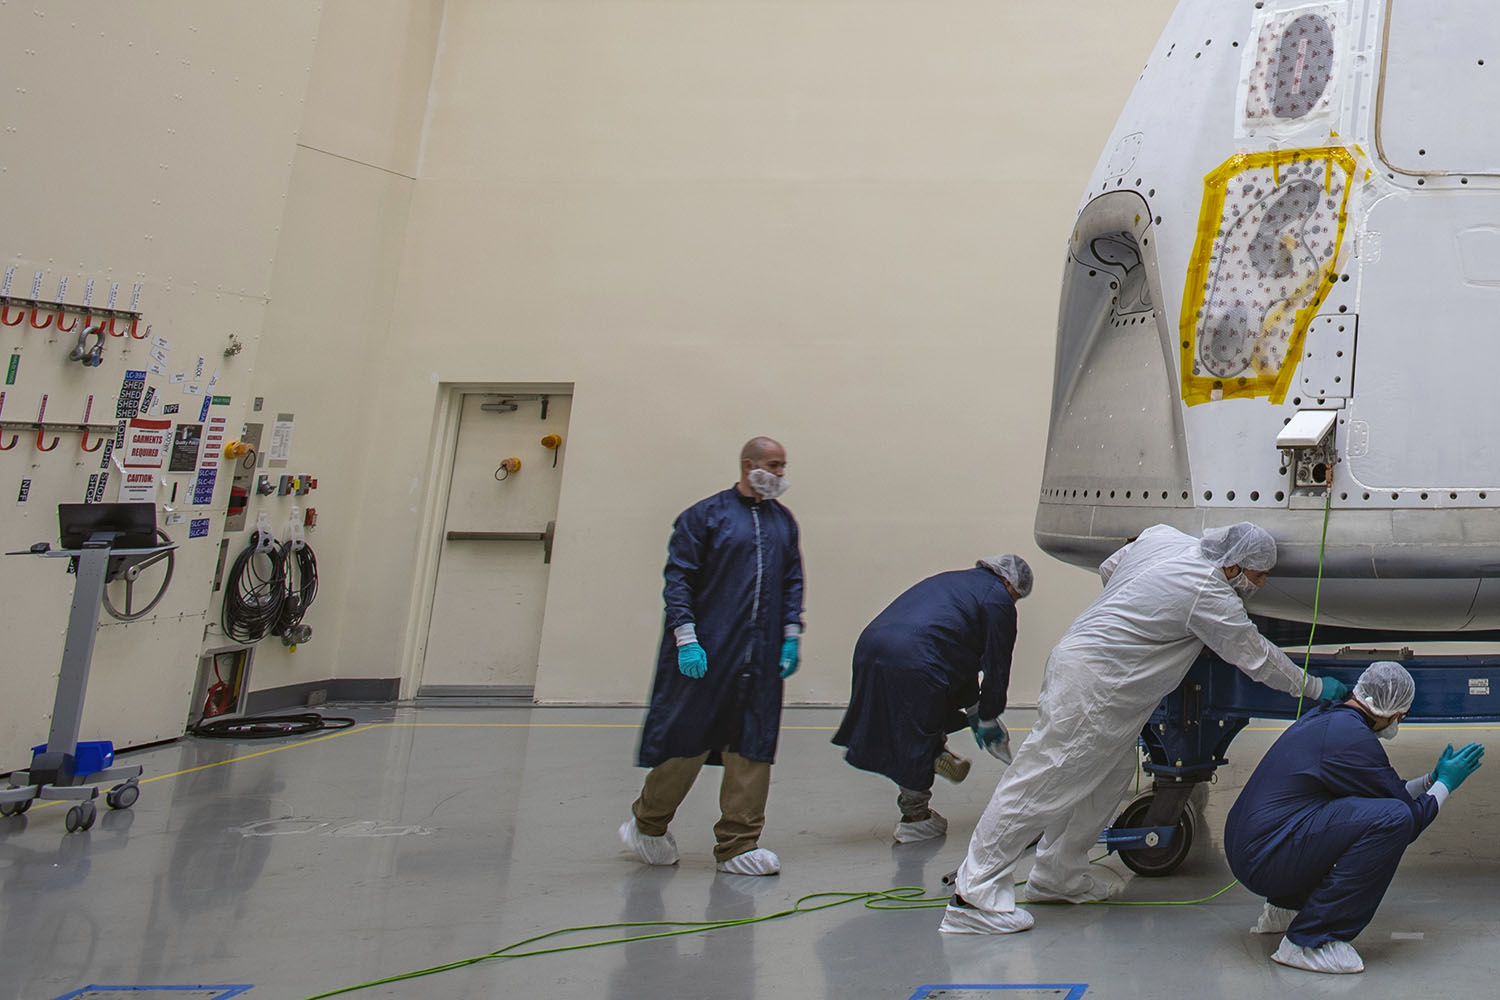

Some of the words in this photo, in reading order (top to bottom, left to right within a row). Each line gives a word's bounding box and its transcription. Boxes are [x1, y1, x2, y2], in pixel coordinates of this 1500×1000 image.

[123, 381, 144, 390] SHED
[121, 390, 142, 400] SHED
[118, 400, 138, 409] SHED
[140, 388, 156, 413] NSSF
[116, 410, 138, 418] SHED
[164, 405, 179, 413] NPF
[116, 420, 126, 448] SHOP
[133, 434, 162, 444] GARMENTS
[102, 440, 114, 468] SHOP
[131, 448, 159, 458] REQUIRED
[127, 474, 154, 482] CAUTION:
[20, 480, 30, 501] NPF
[95, 473, 108, 502] SHOP
